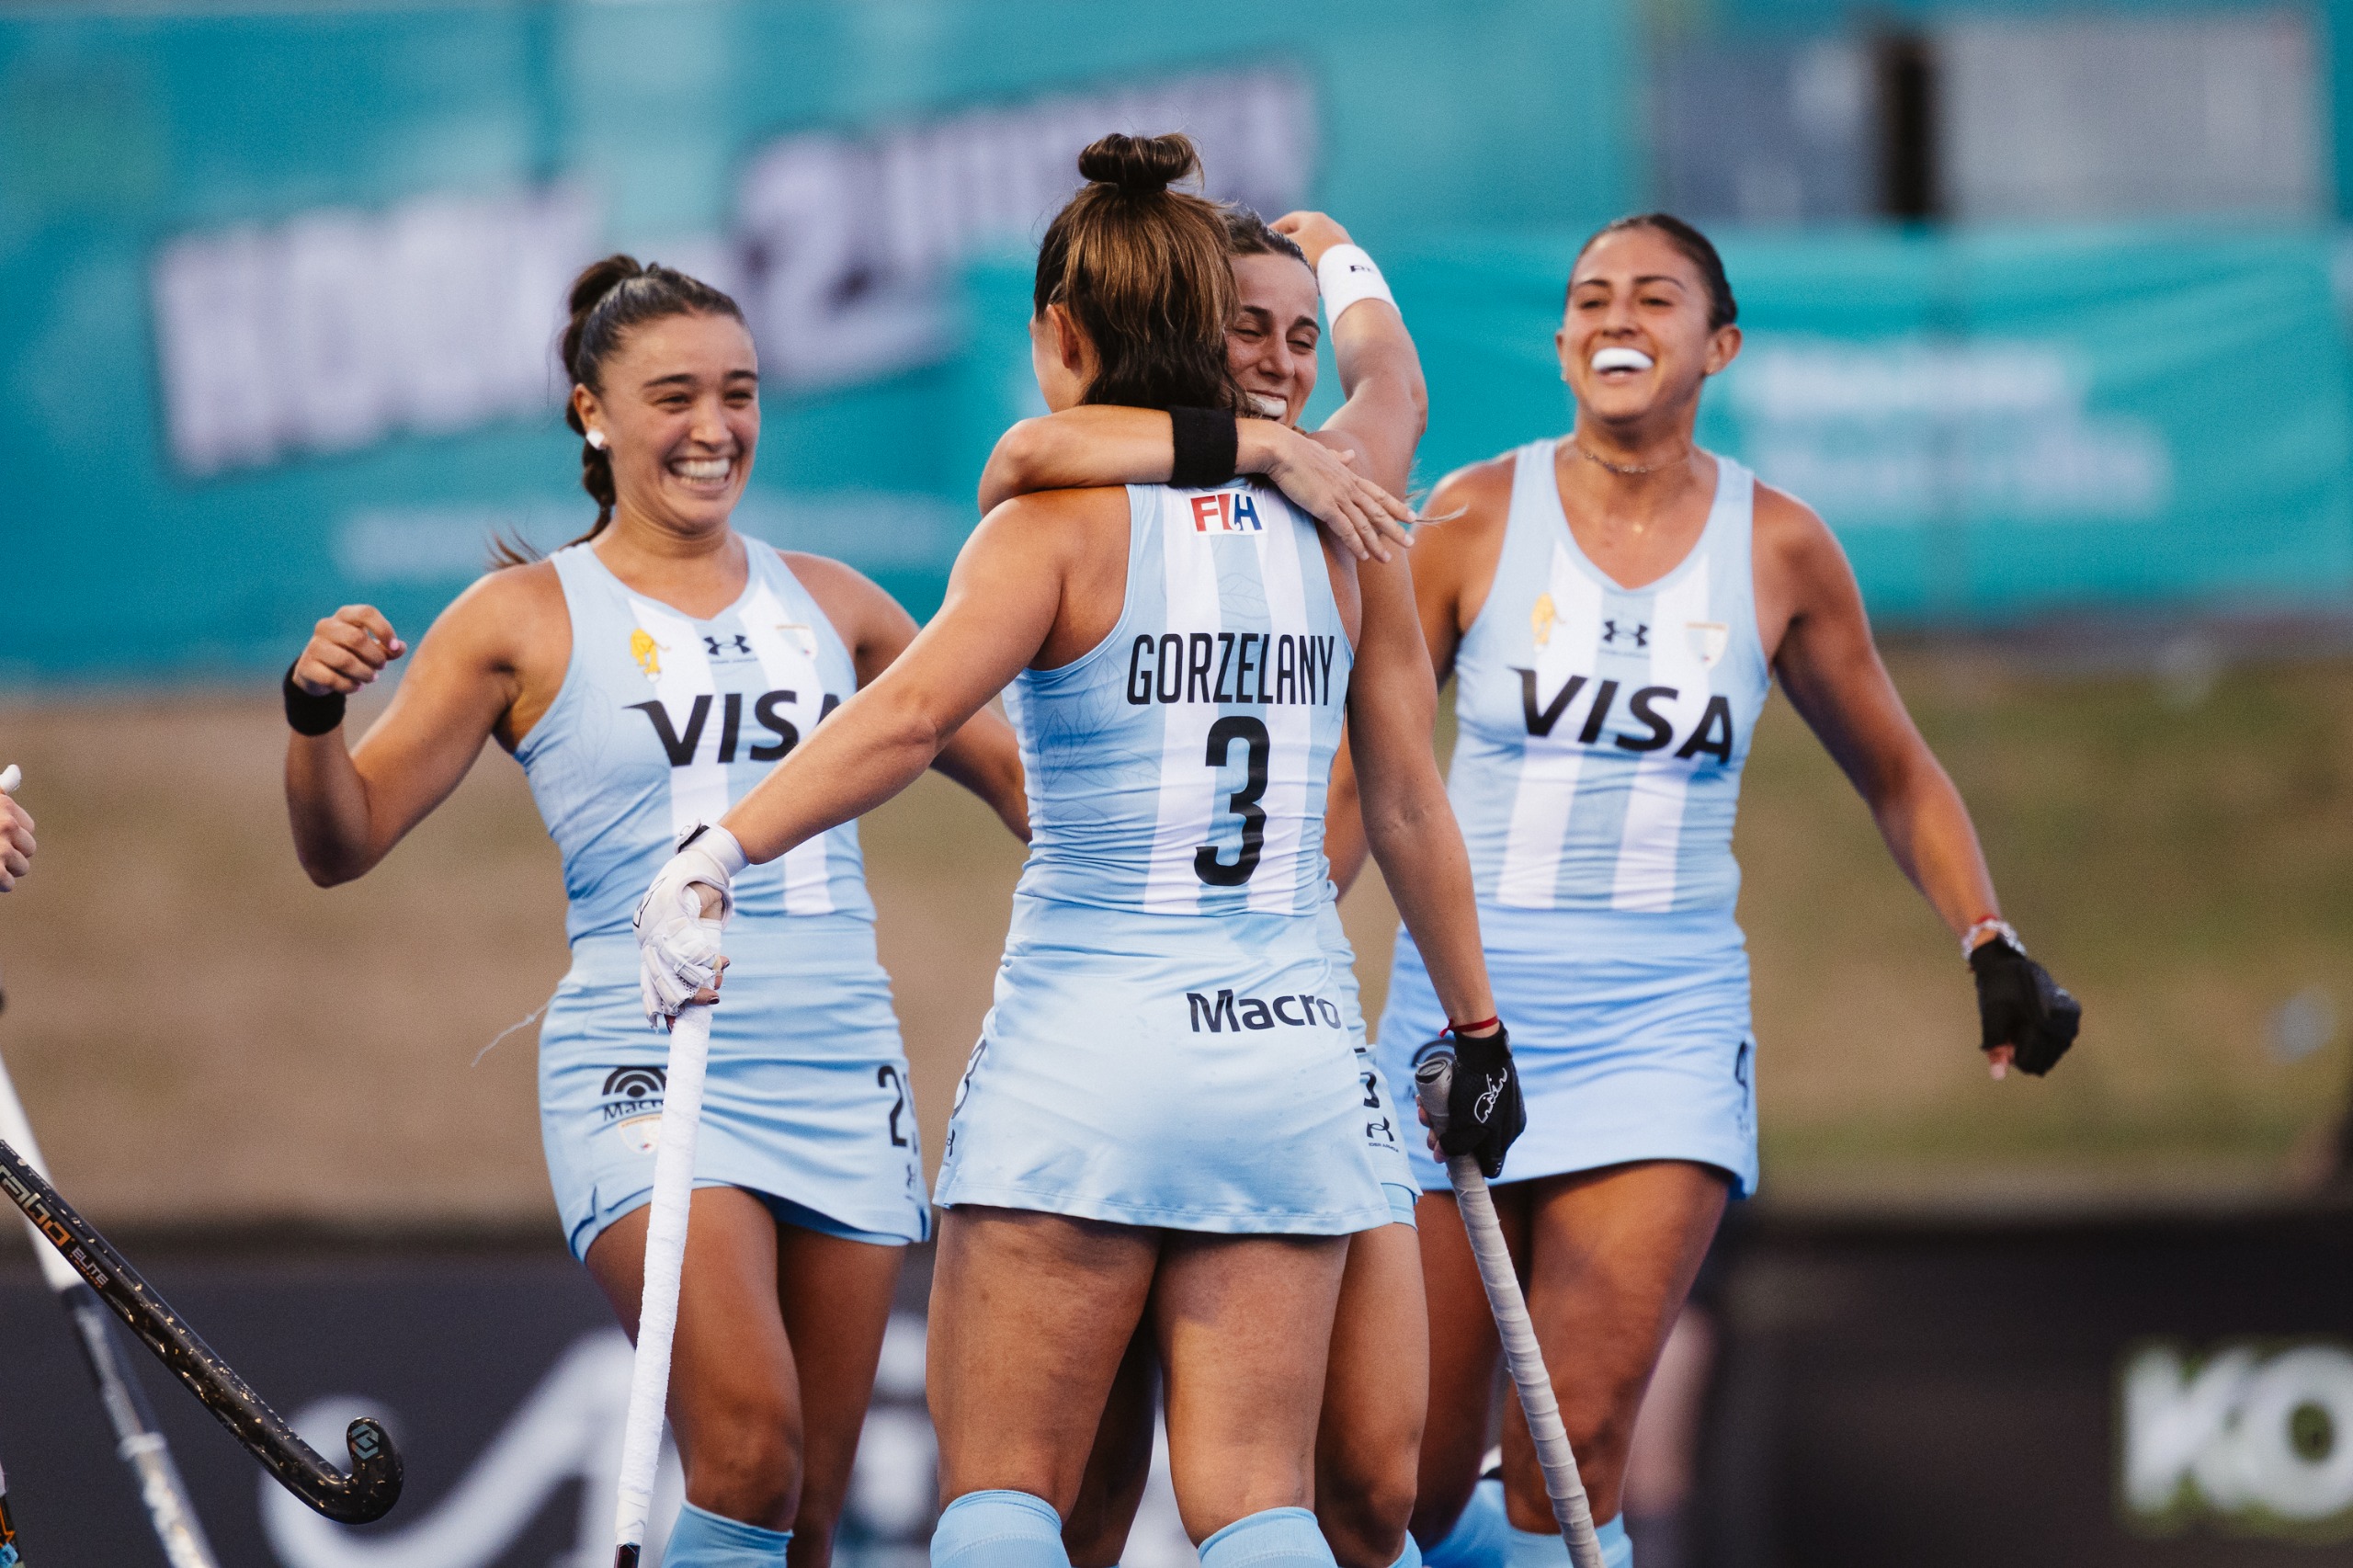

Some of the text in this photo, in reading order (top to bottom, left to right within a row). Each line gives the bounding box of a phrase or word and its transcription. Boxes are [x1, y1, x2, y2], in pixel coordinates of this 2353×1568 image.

[1190, 494, 1263, 532] FIH
[1127, 632, 1335, 706] GORZELANY
[1506, 665, 1733, 766] VISA
[1194, 716, 1270, 886] 3
[1187, 989, 1342, 1033] Macro
[604, 1099, 664, 1122] Macr
[71, 1247, 108, 1285] ELITE
